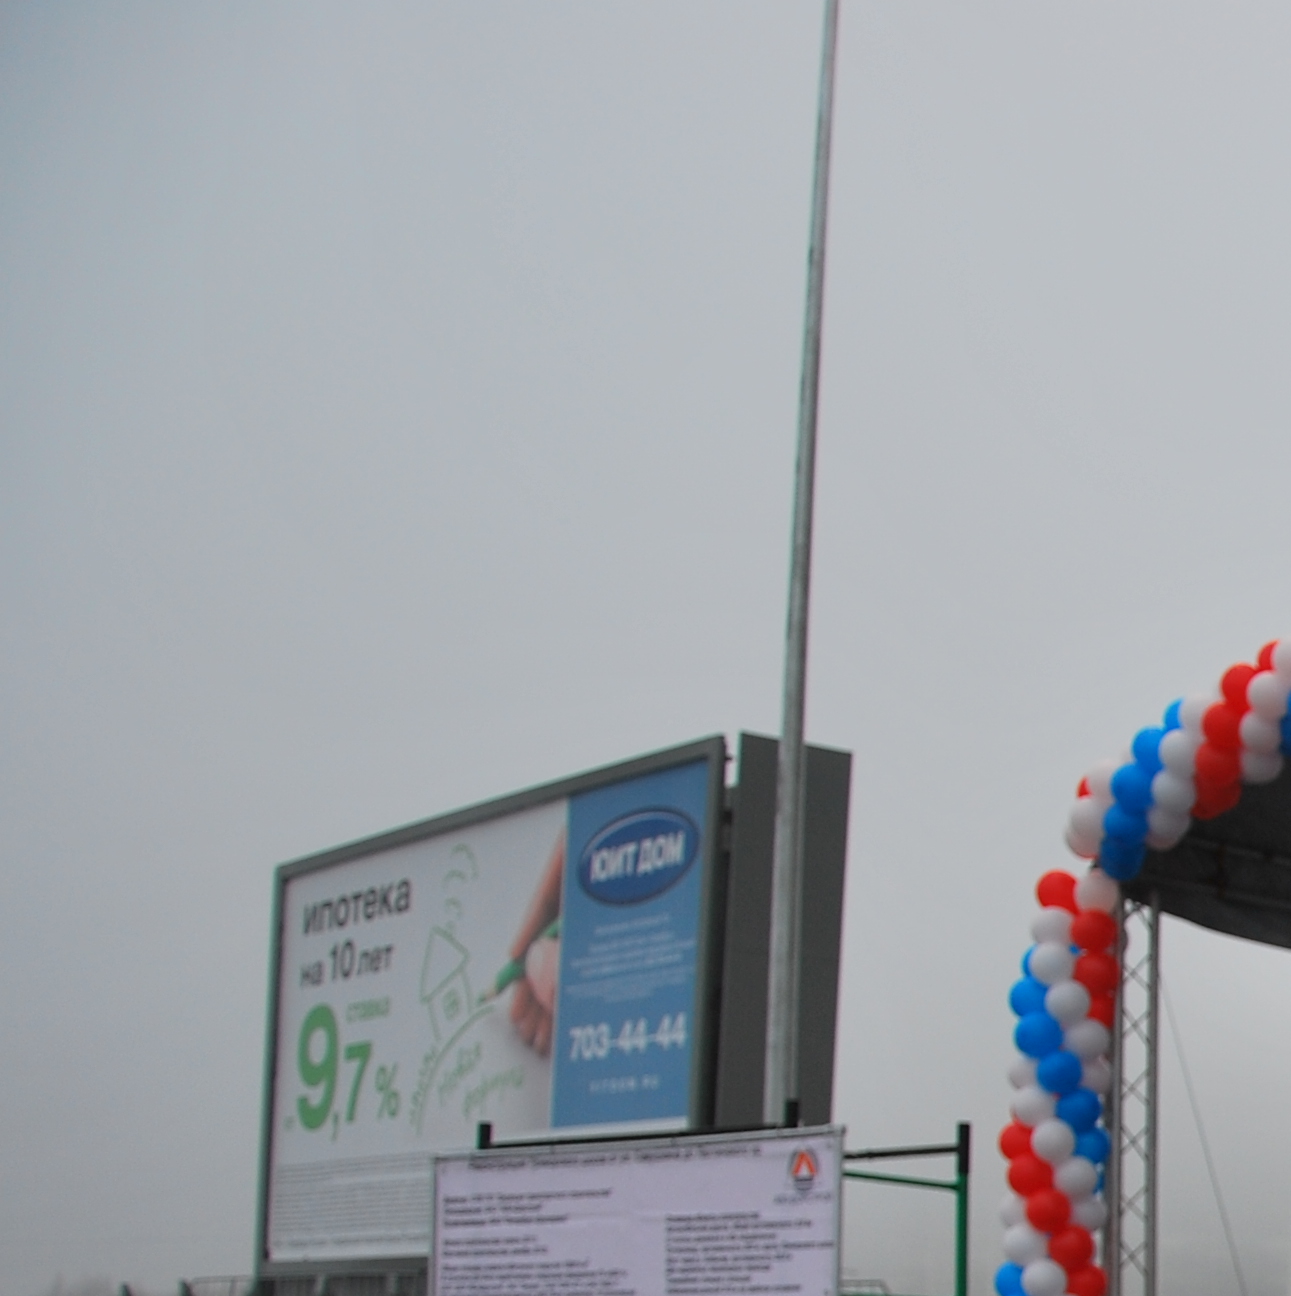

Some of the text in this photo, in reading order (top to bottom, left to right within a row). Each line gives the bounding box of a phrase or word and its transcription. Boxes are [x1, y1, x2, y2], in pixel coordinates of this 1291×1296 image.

[590, 830, 686, 884] ЮИТ ДОМ
[302, 878, 412, 935] ипотека
[299, 938, 395, 987] на 10 лет
[568, 1011, 687, 1062] 703-44-44
